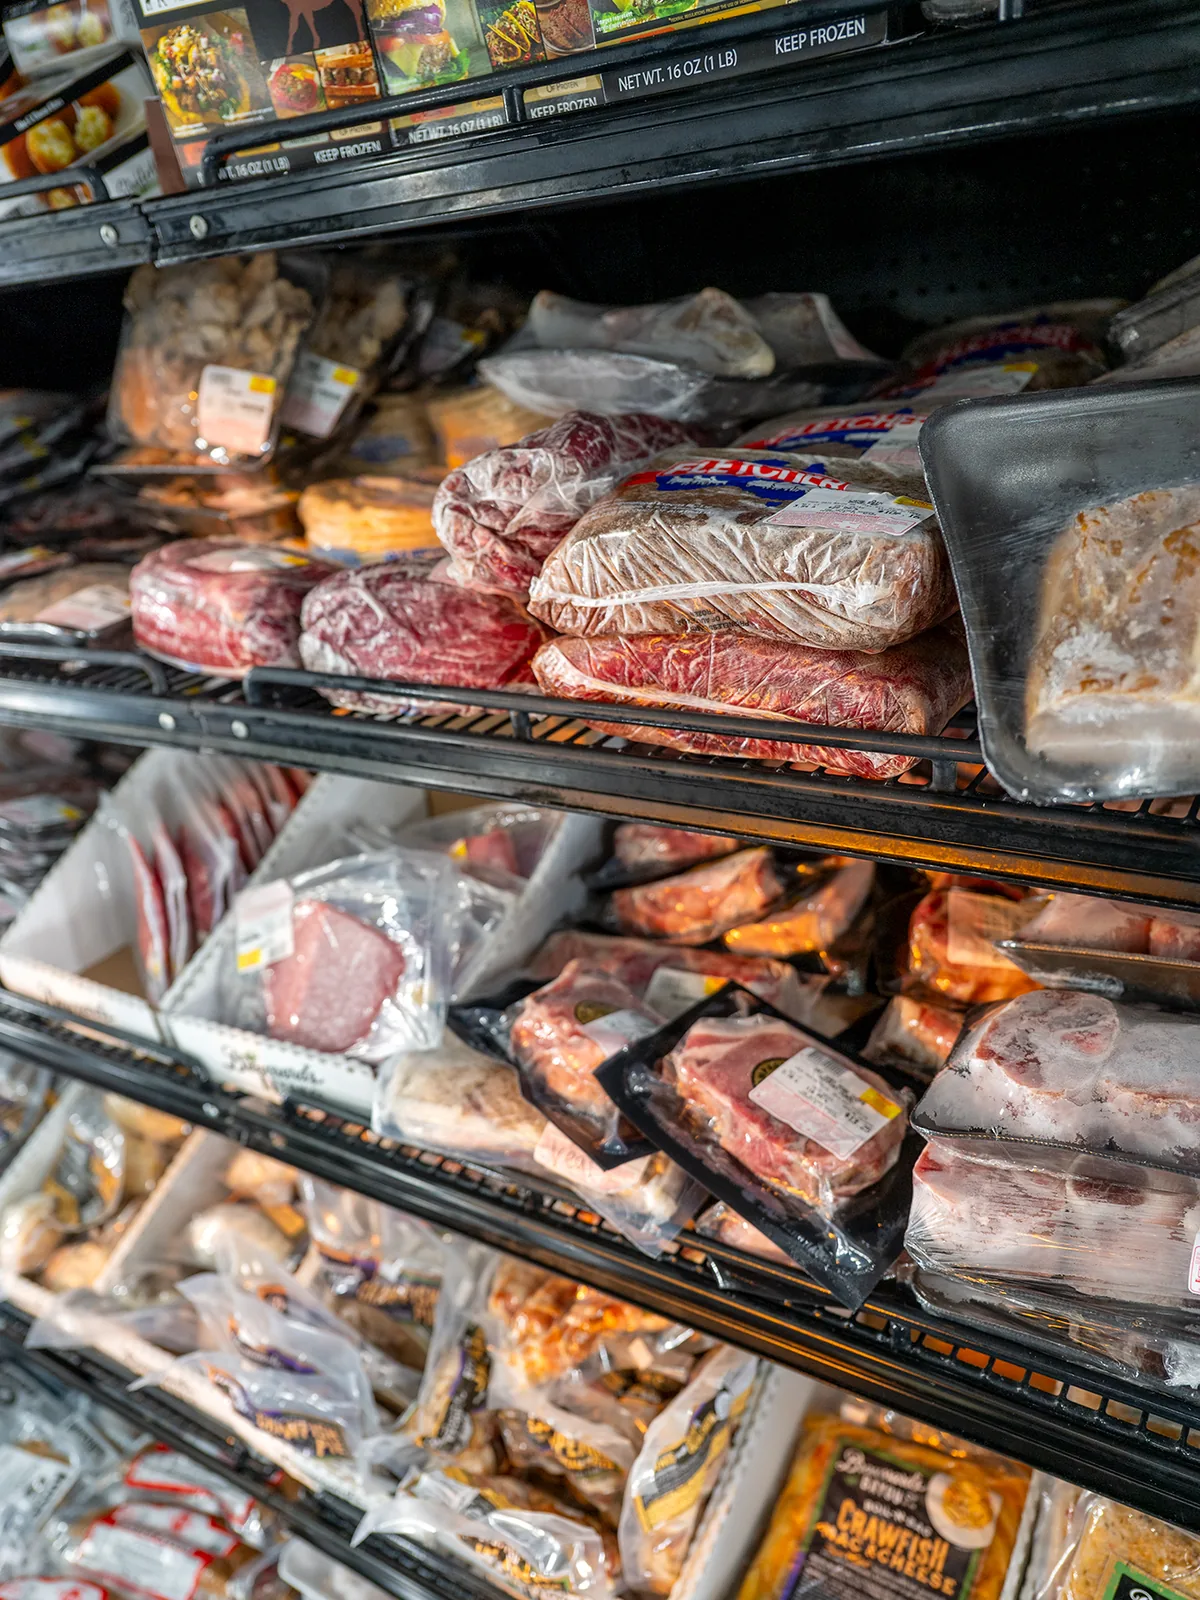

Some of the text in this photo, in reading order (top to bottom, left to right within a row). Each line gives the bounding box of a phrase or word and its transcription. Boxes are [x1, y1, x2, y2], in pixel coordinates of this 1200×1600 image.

[774, 18, 866, 55] KEEP FROZEN
[618, 48, 738, 93] NET WT. 16 OZ (1 LB)
[530, 96, 598, 120] KEEP FROZEN
[408, 128, 428, 144] NET
[448, 123, 461, 137] 16
[461, 119, 475, 134] OZ
[313, 146, 340, 164] KEEP
[340, 140, 382, 159] FROZEN
[235, 163, 250, 178] 16
[248, 160, 263, 176] OZ
[836, 1498, 950, 1574] CRAWFISH
[876, 1547, 959, 1597] CHEESE
